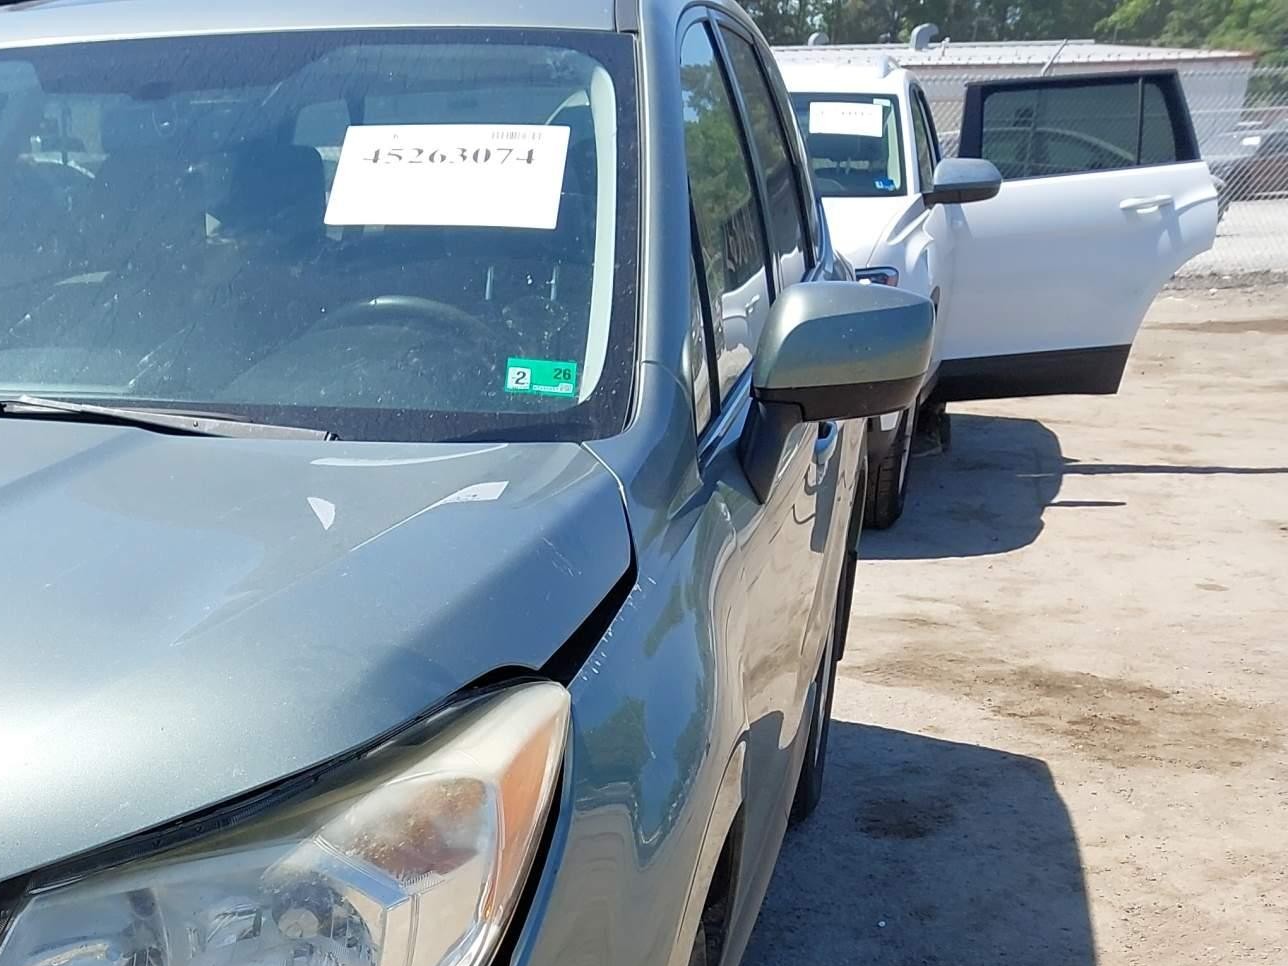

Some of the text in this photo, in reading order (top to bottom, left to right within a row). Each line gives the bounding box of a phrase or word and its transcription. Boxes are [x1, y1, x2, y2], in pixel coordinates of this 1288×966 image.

[363, 147, 535, 165] 45263074
[515, 367, 572, 385] 2 26
